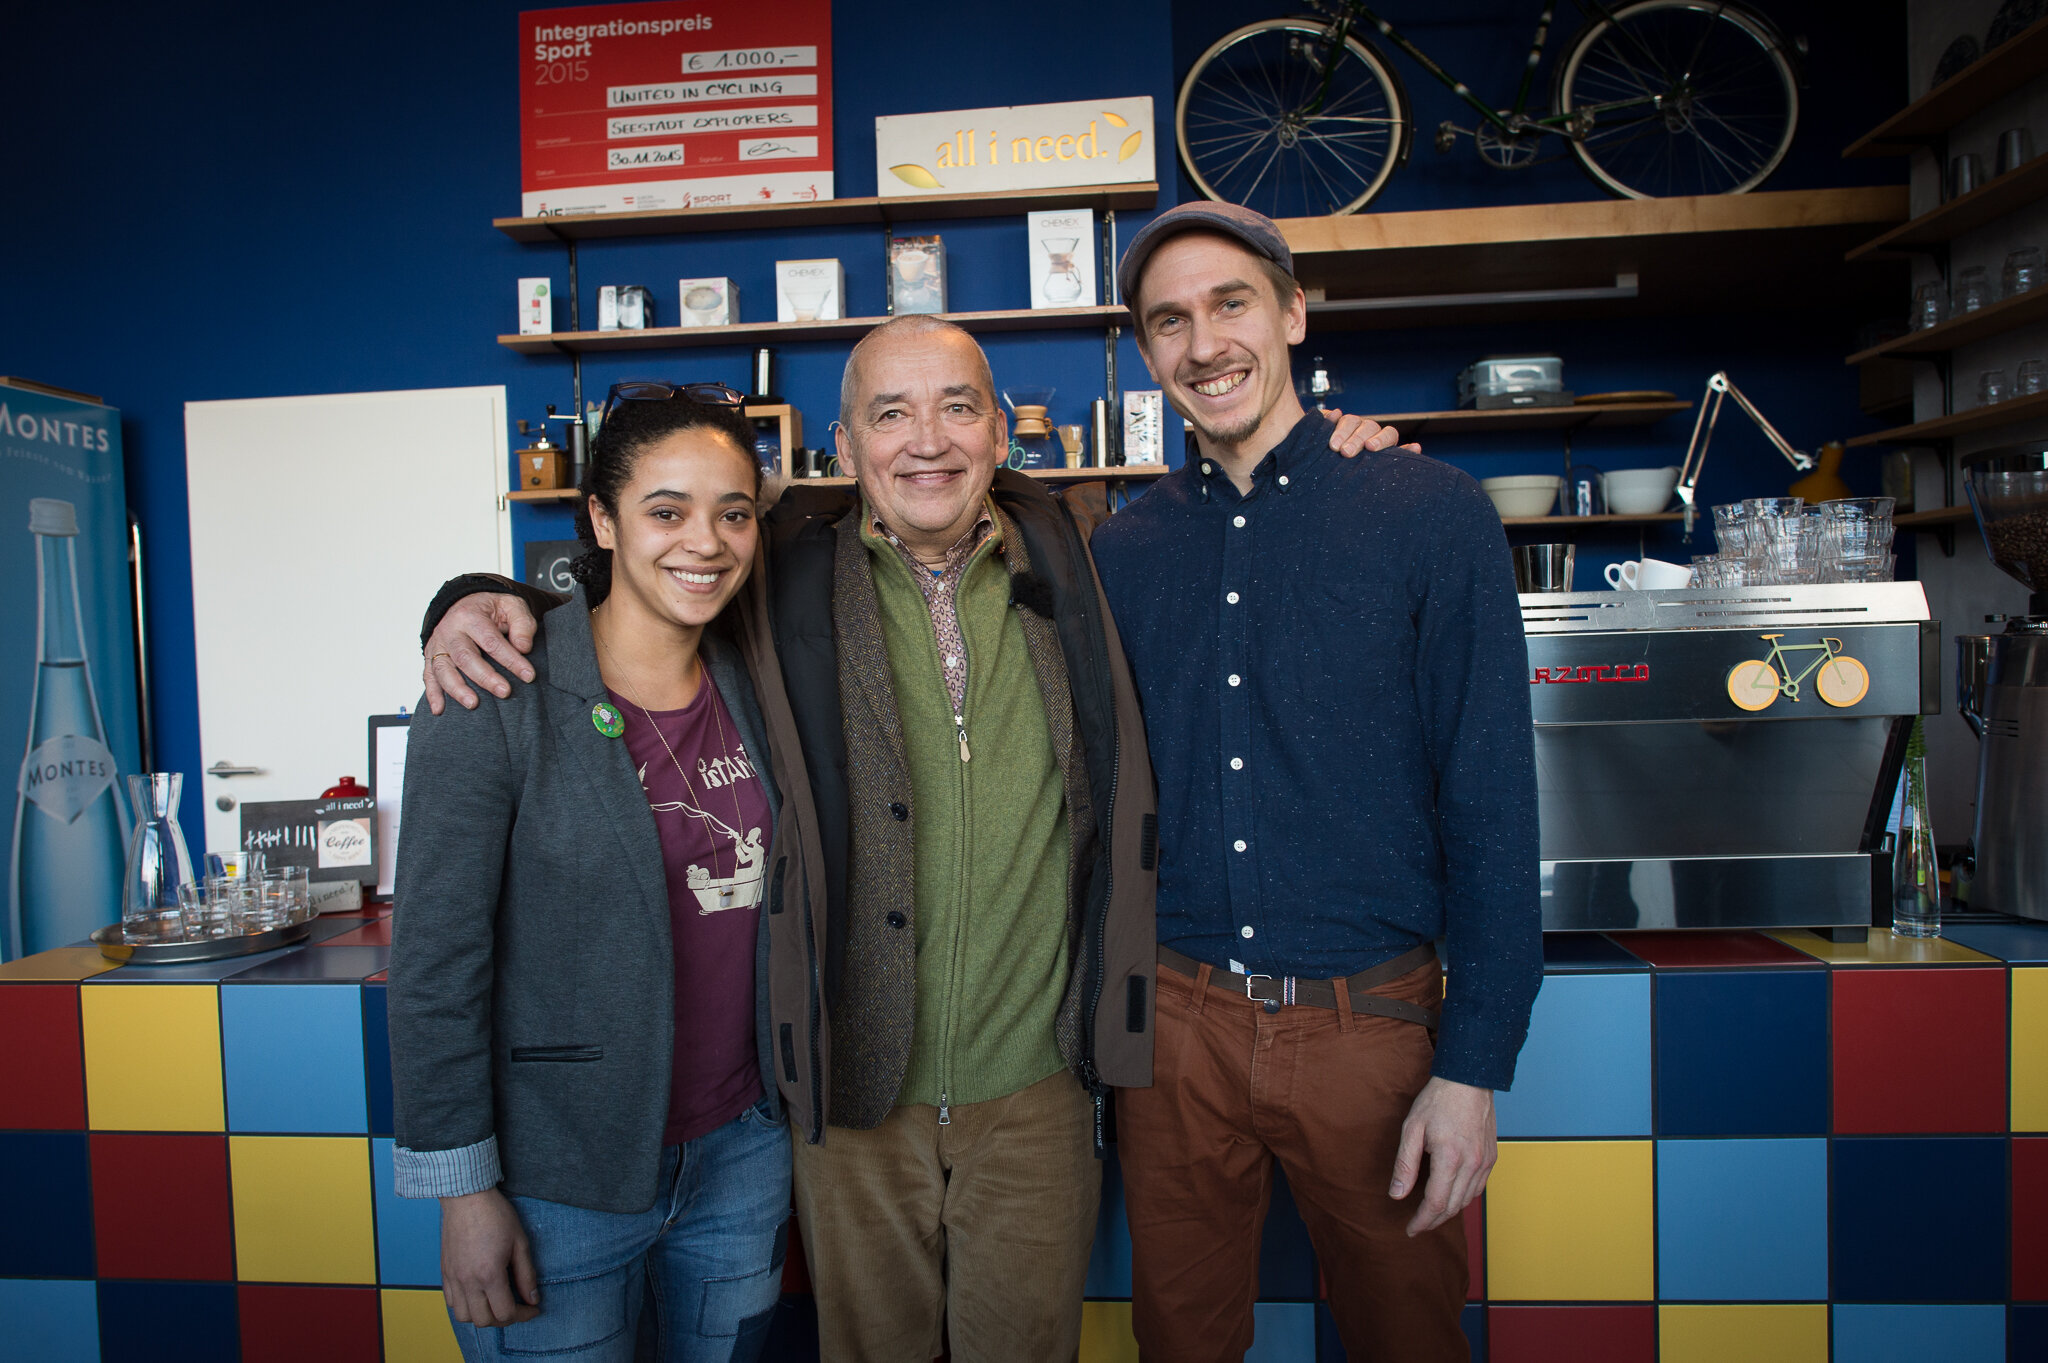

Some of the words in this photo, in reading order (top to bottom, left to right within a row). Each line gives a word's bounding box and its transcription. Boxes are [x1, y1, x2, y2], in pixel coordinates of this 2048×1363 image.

[535, 14, 712, 42] Integrationspreis
[535, 41, 592, 62] Sport
[688, 54, 704, 71] €
[535, 61, 589, 85] 2015
[613, 88, 675, 104] UNITED
[683, 87, 699, 99] IN
[706, 81, 783, 96] CYCLING
[612, 119, 685, 136] SEESTADT
[693, 112, 793, 129] EXPLORERS
[936, 129, 978, 168] all
[989, 131, 999, 165] i
[1011, 120, 1108, 163] need.
[610, 149, 682, 166] 30.11.2015
[694, 192, 732, 206] SPORT
[0, 402, 110, 453] MONTES
[1530, 664, 1649, 683] RZOCCO
[27, 760, 106, 791] MONTES
[326, 801, 336, 811] all
[343, 800, 364, 810] need
[326, 836, 364, 850] Coffee
